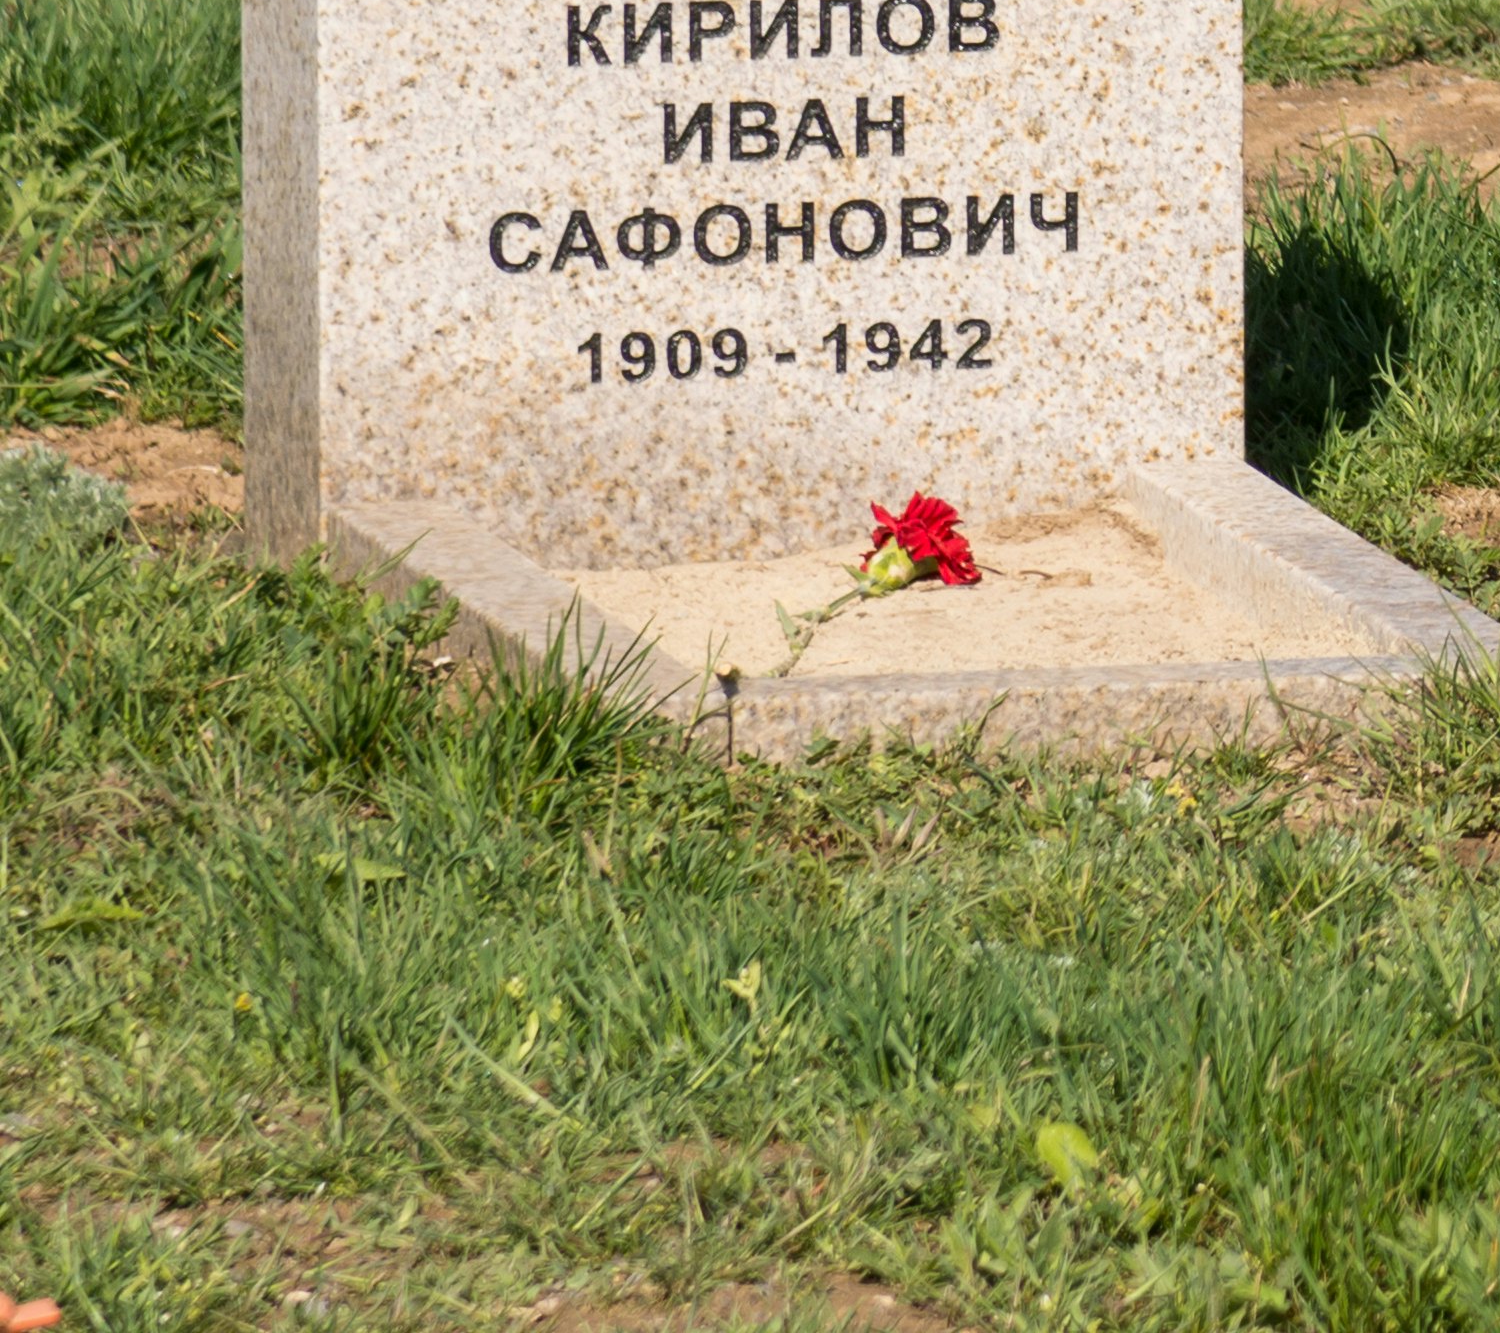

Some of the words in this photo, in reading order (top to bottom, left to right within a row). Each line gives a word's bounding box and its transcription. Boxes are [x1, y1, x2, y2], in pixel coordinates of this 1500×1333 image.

[662, 95, 905, 163] ИВАН
[489, 192, 1079, 274] САФОНОВИЧ
[577, 327, 749, 383] 1909
[823, 319, 994, 373] 1942
